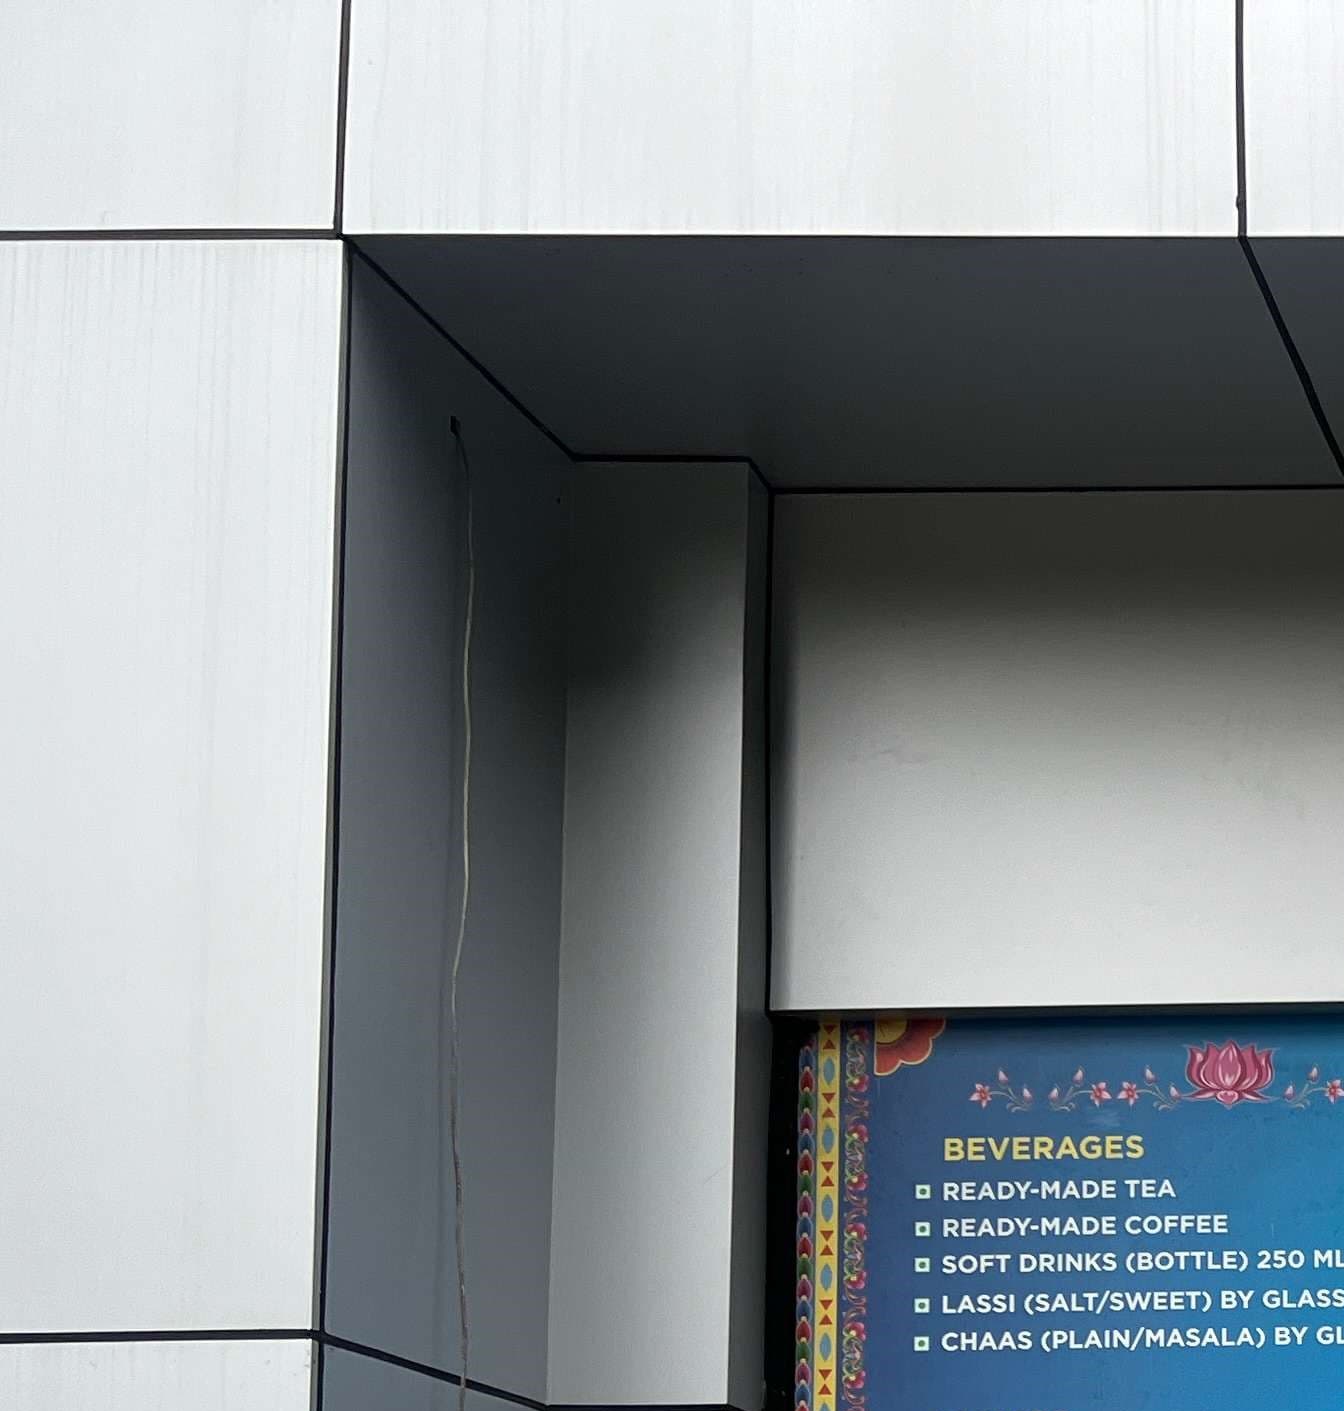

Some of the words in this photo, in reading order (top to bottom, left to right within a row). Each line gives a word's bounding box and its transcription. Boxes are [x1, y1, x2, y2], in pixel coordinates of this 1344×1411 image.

[944, 1135, 1145, 1161] BEVERAGES
[943, 1179, 1117, 1201] READY-MADE
[1124, 1179, 1177, 1198] TEA
[943, 1216, 1117, 1238] READY-MADE
[1124, 1214, 1228, 1235] COFFEE
[942, 1254, 1012, 1274] SOFT
[1019, 1252, 1118, 1273] DRINKS
[1125, 1250, 1249, 1274] (BOTTLE)
[1257, 1249, 1305, 1269] 250
[942, 1293, 1015, 1314] LASSI
[1023, 1290, 1212, 1316] (SALT/SWEET)
[1220, 1290, 1255, 1309] BY
[941, 1330, 1033, 1352] CHAAS
[1041, 1326, 1266, 1353] (PLAIN/MASALA)
[1274, 1326, 1309, 1346] BY
